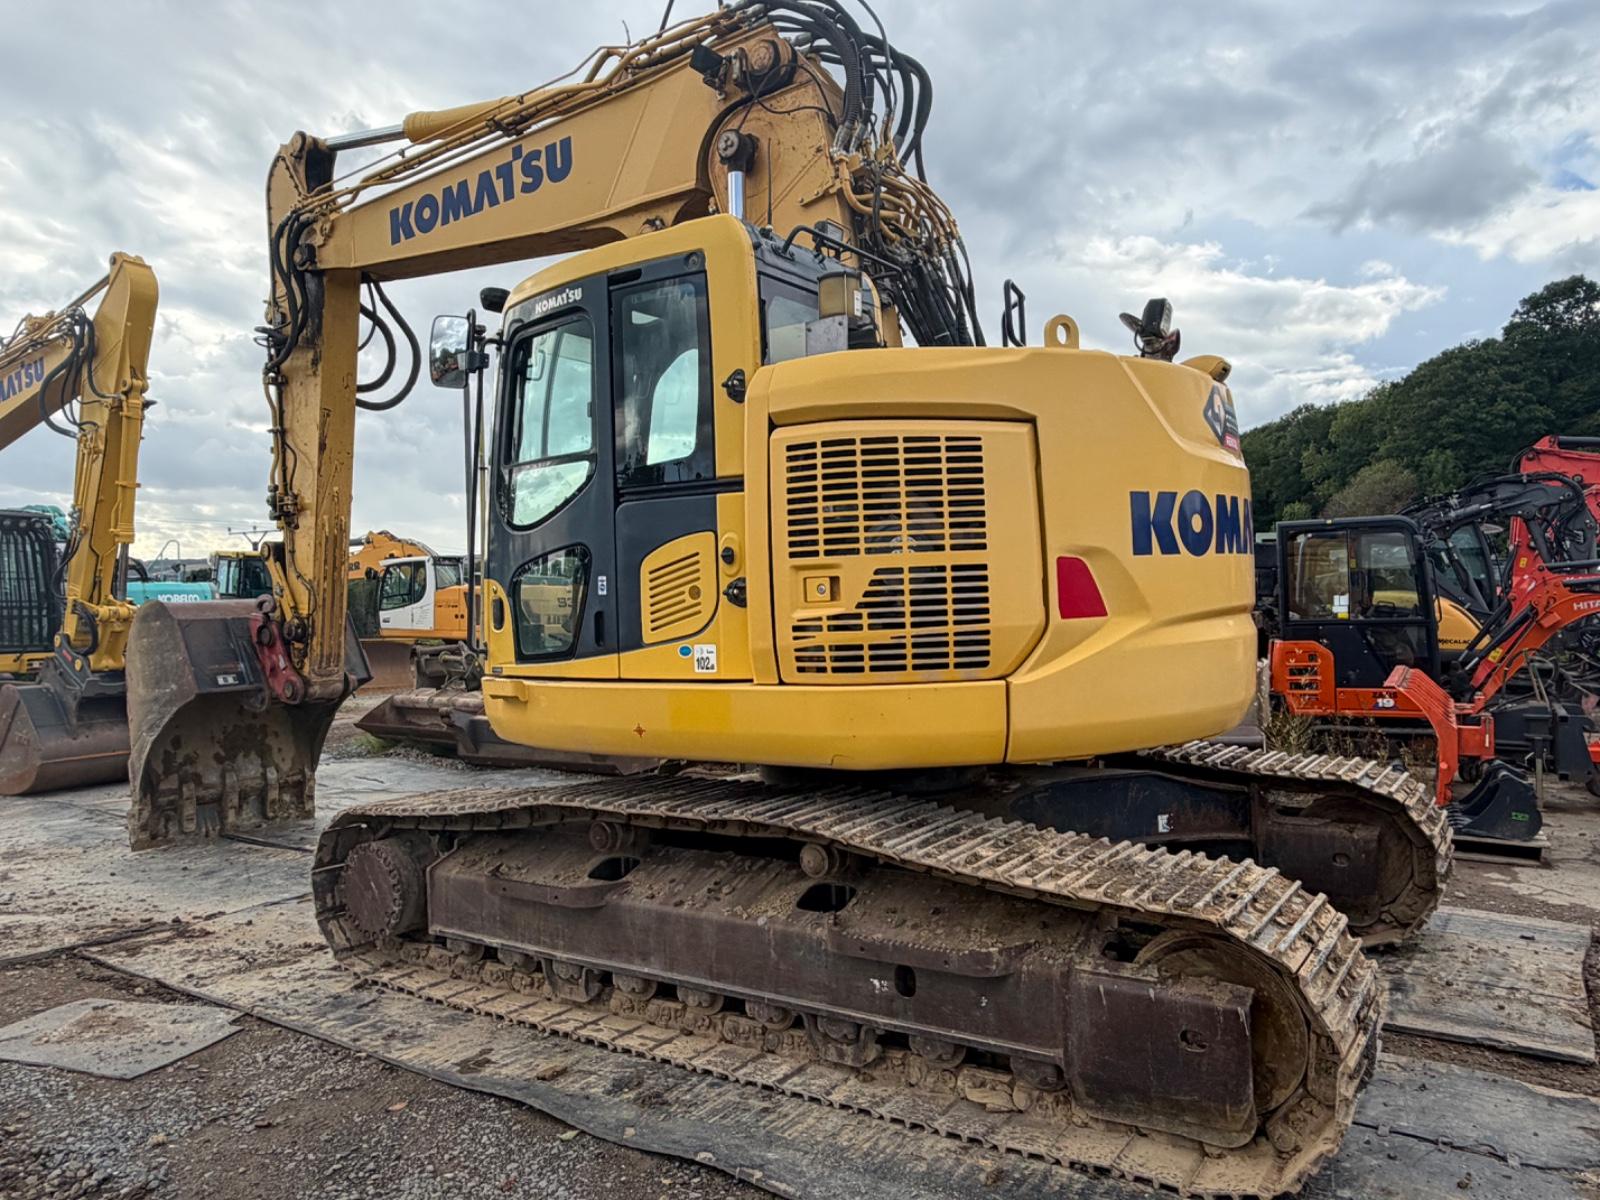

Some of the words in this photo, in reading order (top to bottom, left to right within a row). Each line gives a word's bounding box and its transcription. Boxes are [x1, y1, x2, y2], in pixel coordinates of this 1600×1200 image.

[389, 136, 573, 246] KOMATSU
[535, 287, 582, 315] KOMATSU
[696, 656, 710, 671] 102
[1376, 698, 1395, 708] 19
